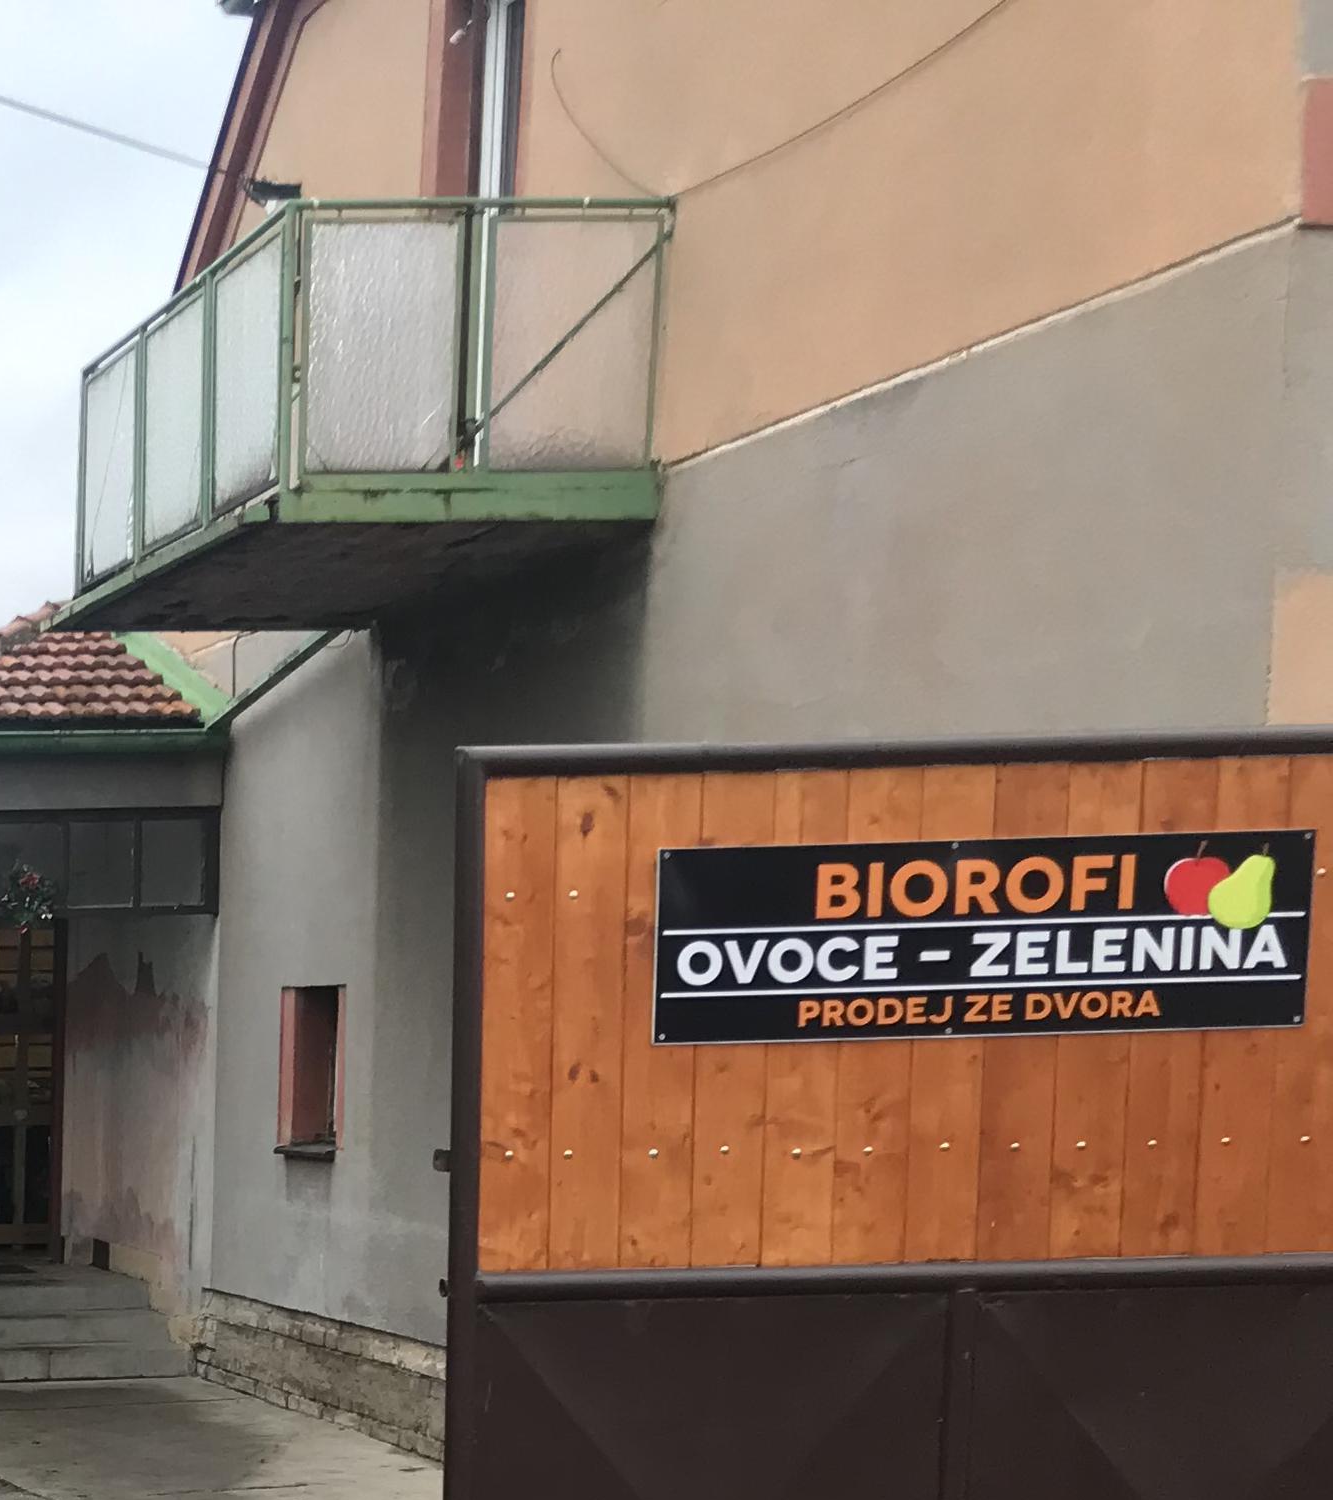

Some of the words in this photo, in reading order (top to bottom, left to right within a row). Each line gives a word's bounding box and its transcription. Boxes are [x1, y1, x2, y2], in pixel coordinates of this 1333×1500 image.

[815, 854, 1137, 920] BIOROFI
[676, 935, 899, 986] OVOCE
[969, 924, 1287, 979] ZELENINA
[797, 996, 953, 1029] PRODEJ
[963, 995, 1014, 1024] ZE
[1024, 989, 1161, 1022] DVORA
